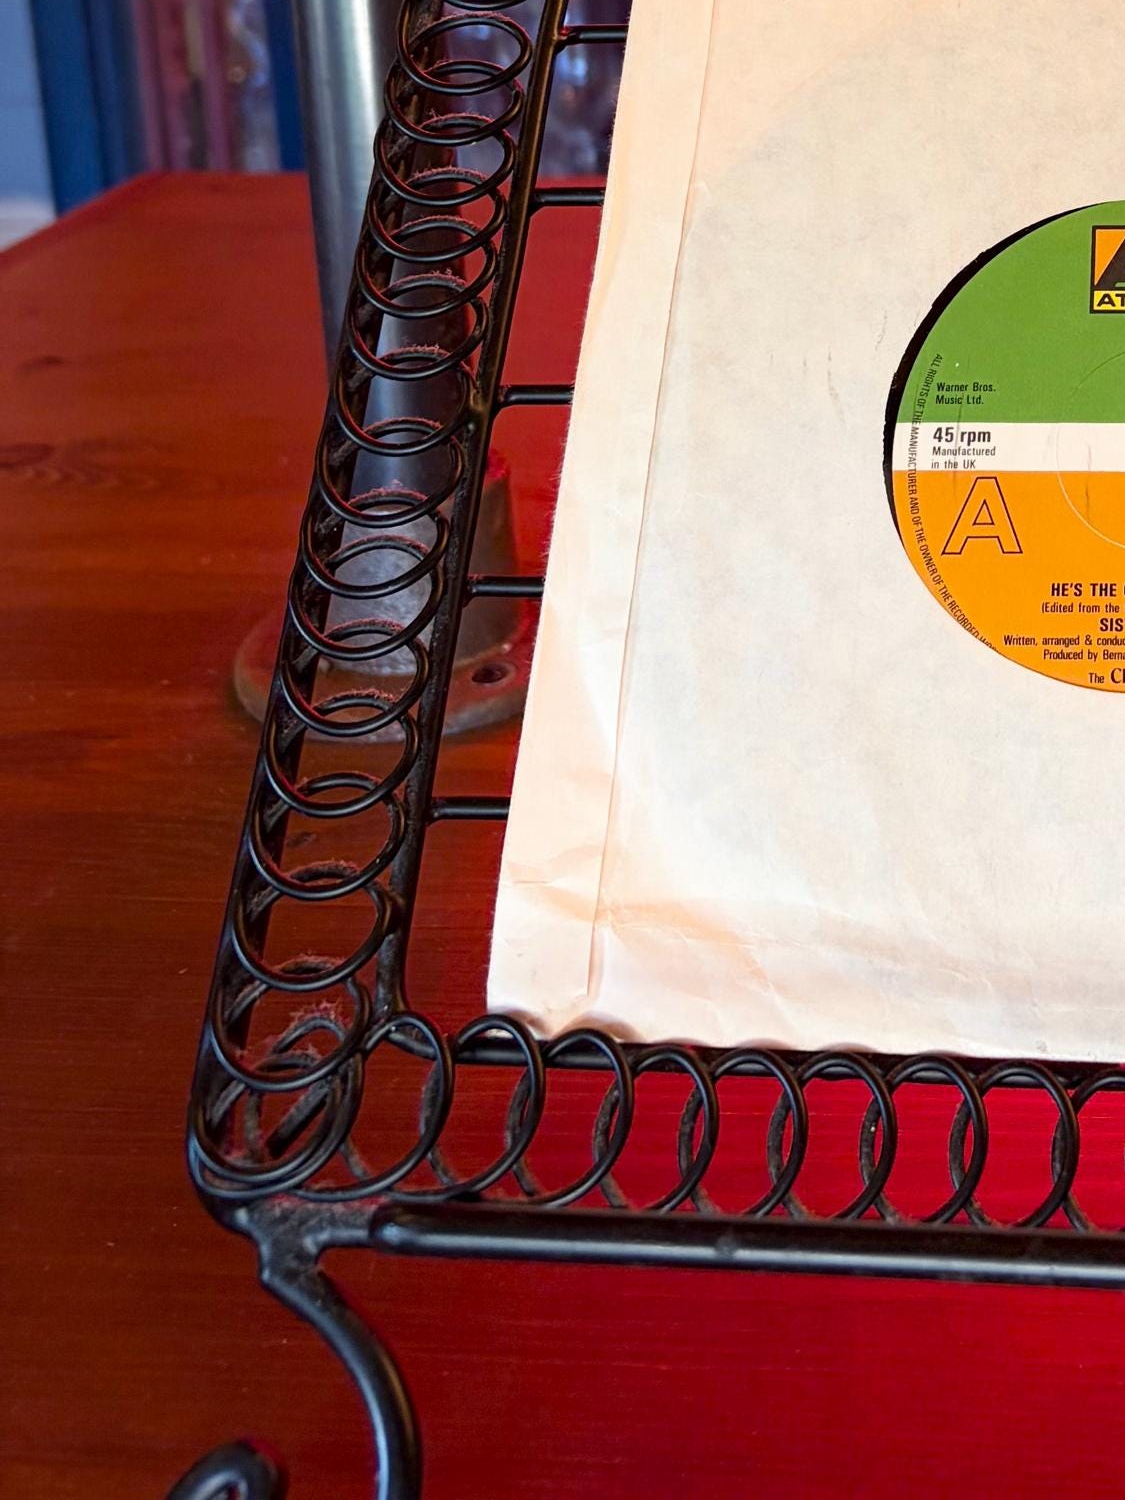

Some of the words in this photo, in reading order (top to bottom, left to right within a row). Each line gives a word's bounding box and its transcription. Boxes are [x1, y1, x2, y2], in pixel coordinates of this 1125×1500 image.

[931, 353, 943, 368] ALL
[919, 368, 937, 396] RIGHTS
[936, 382, 969, 392] Warner
[972, 382, 997, 392] Bros.
[916, 397, 927, 410] OF
[935, 394, 963, 405] Music
[966, 394, 984, 405] Ltd.
[912, 409, 924, 424] THE
[933, 427, 954, 443] 45
[960, 430, 991, 447] rpm
[932, 446, 996, 456] Manufactured
[907, 426, 919, 495] MANUFACTURER
[931, 460, 940, 469] in
[944, 460, 959, 469] the
[963, 459, 976, 469] UK
[909, 497, 920, 515] AND
[911, 516, 922, 527] OF
[941, 476, 1024, 556] A
[914, 527, 926, 543] THE
[919, 544, 938, 576] OWNER
[932, 575, 944, 586] OF
[938, 585, 953, 602] THE
[1051, 583, 1083, 597] HE'S
[1090, 583, 1117, 597] THE
[1041, 602, 1074, 614] (Edited
[1078, 602, 1100, 613] from
[1105, 603, 1120, 613] the
[1003, 634, 1038, 647] Written,
[1042, 635, 1080, 648] arranged
[1084, 635, 1093, 646] &
[1043, 649, 1083, 660] Produced
[1087, 649, 1099, 662] by
[1088, 672, 1105, 684] The
